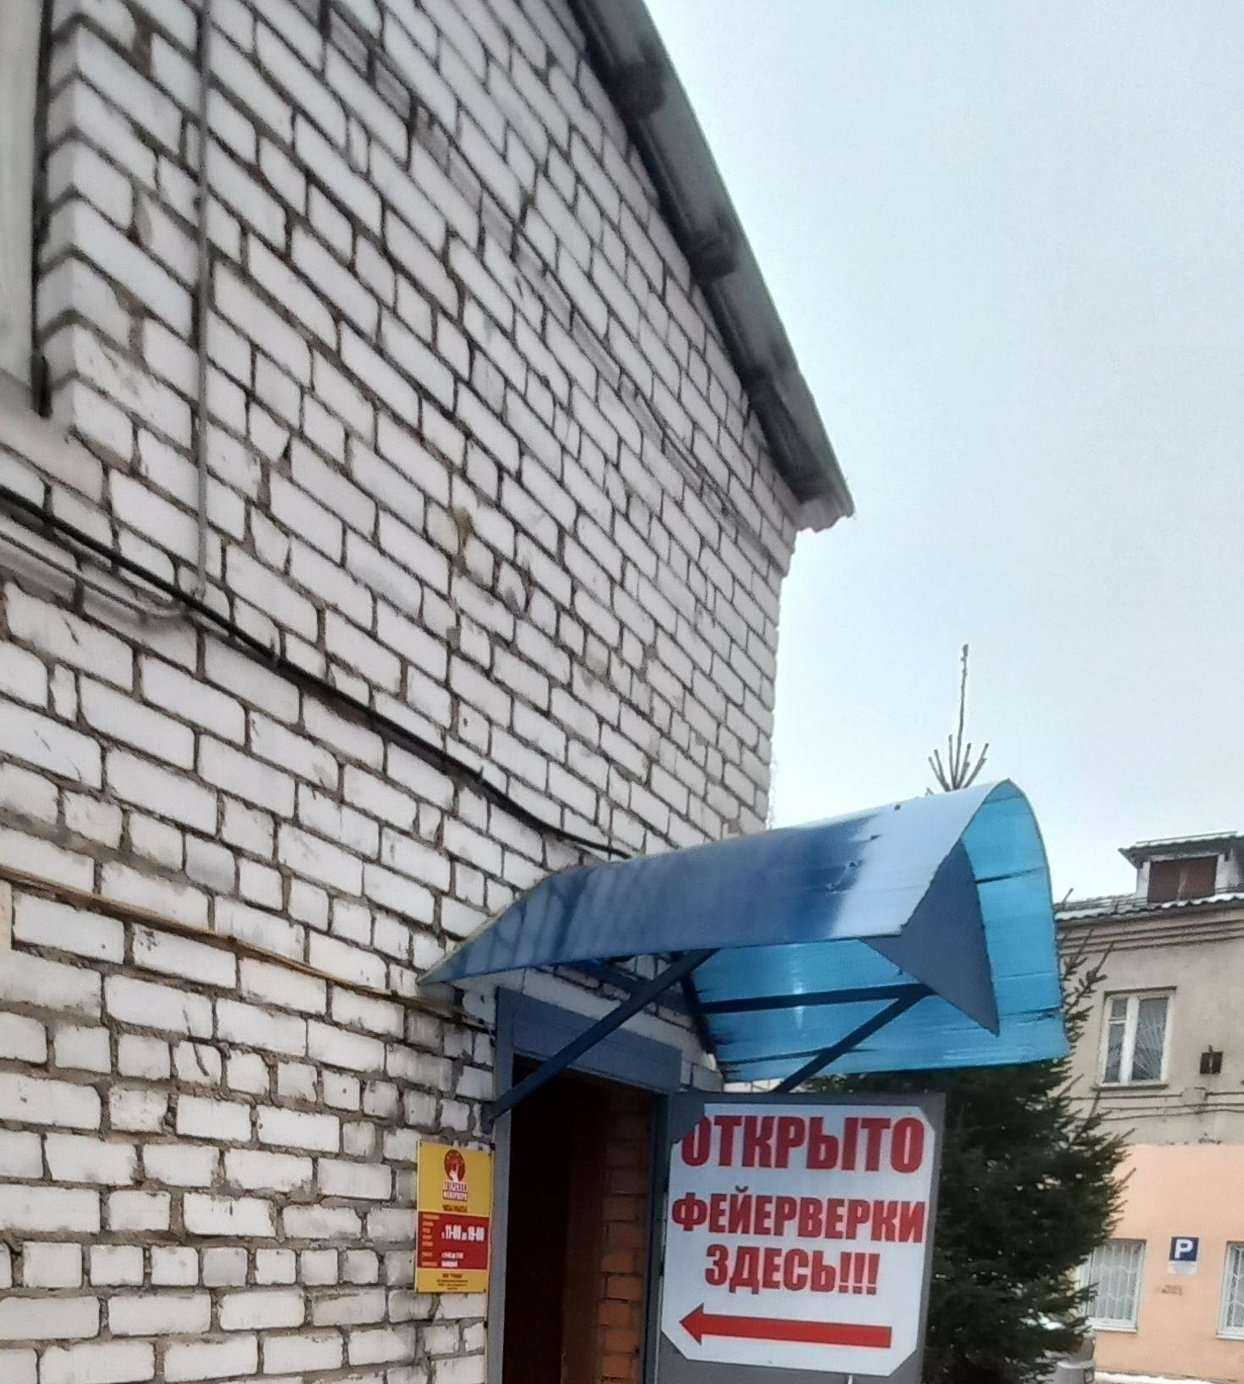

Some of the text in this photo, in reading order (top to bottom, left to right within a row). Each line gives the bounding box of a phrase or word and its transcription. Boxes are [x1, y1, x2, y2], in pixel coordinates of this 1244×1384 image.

[681, 1115, 925, 1173] ОТКРЫТО
[671, 1185, 926, 1243] ФЕЙЕРВЕРКИ
[704, 1244, 881, 1295] ЗДЕСЬ!!!
[1174, 1239, 1193, 1260] P
